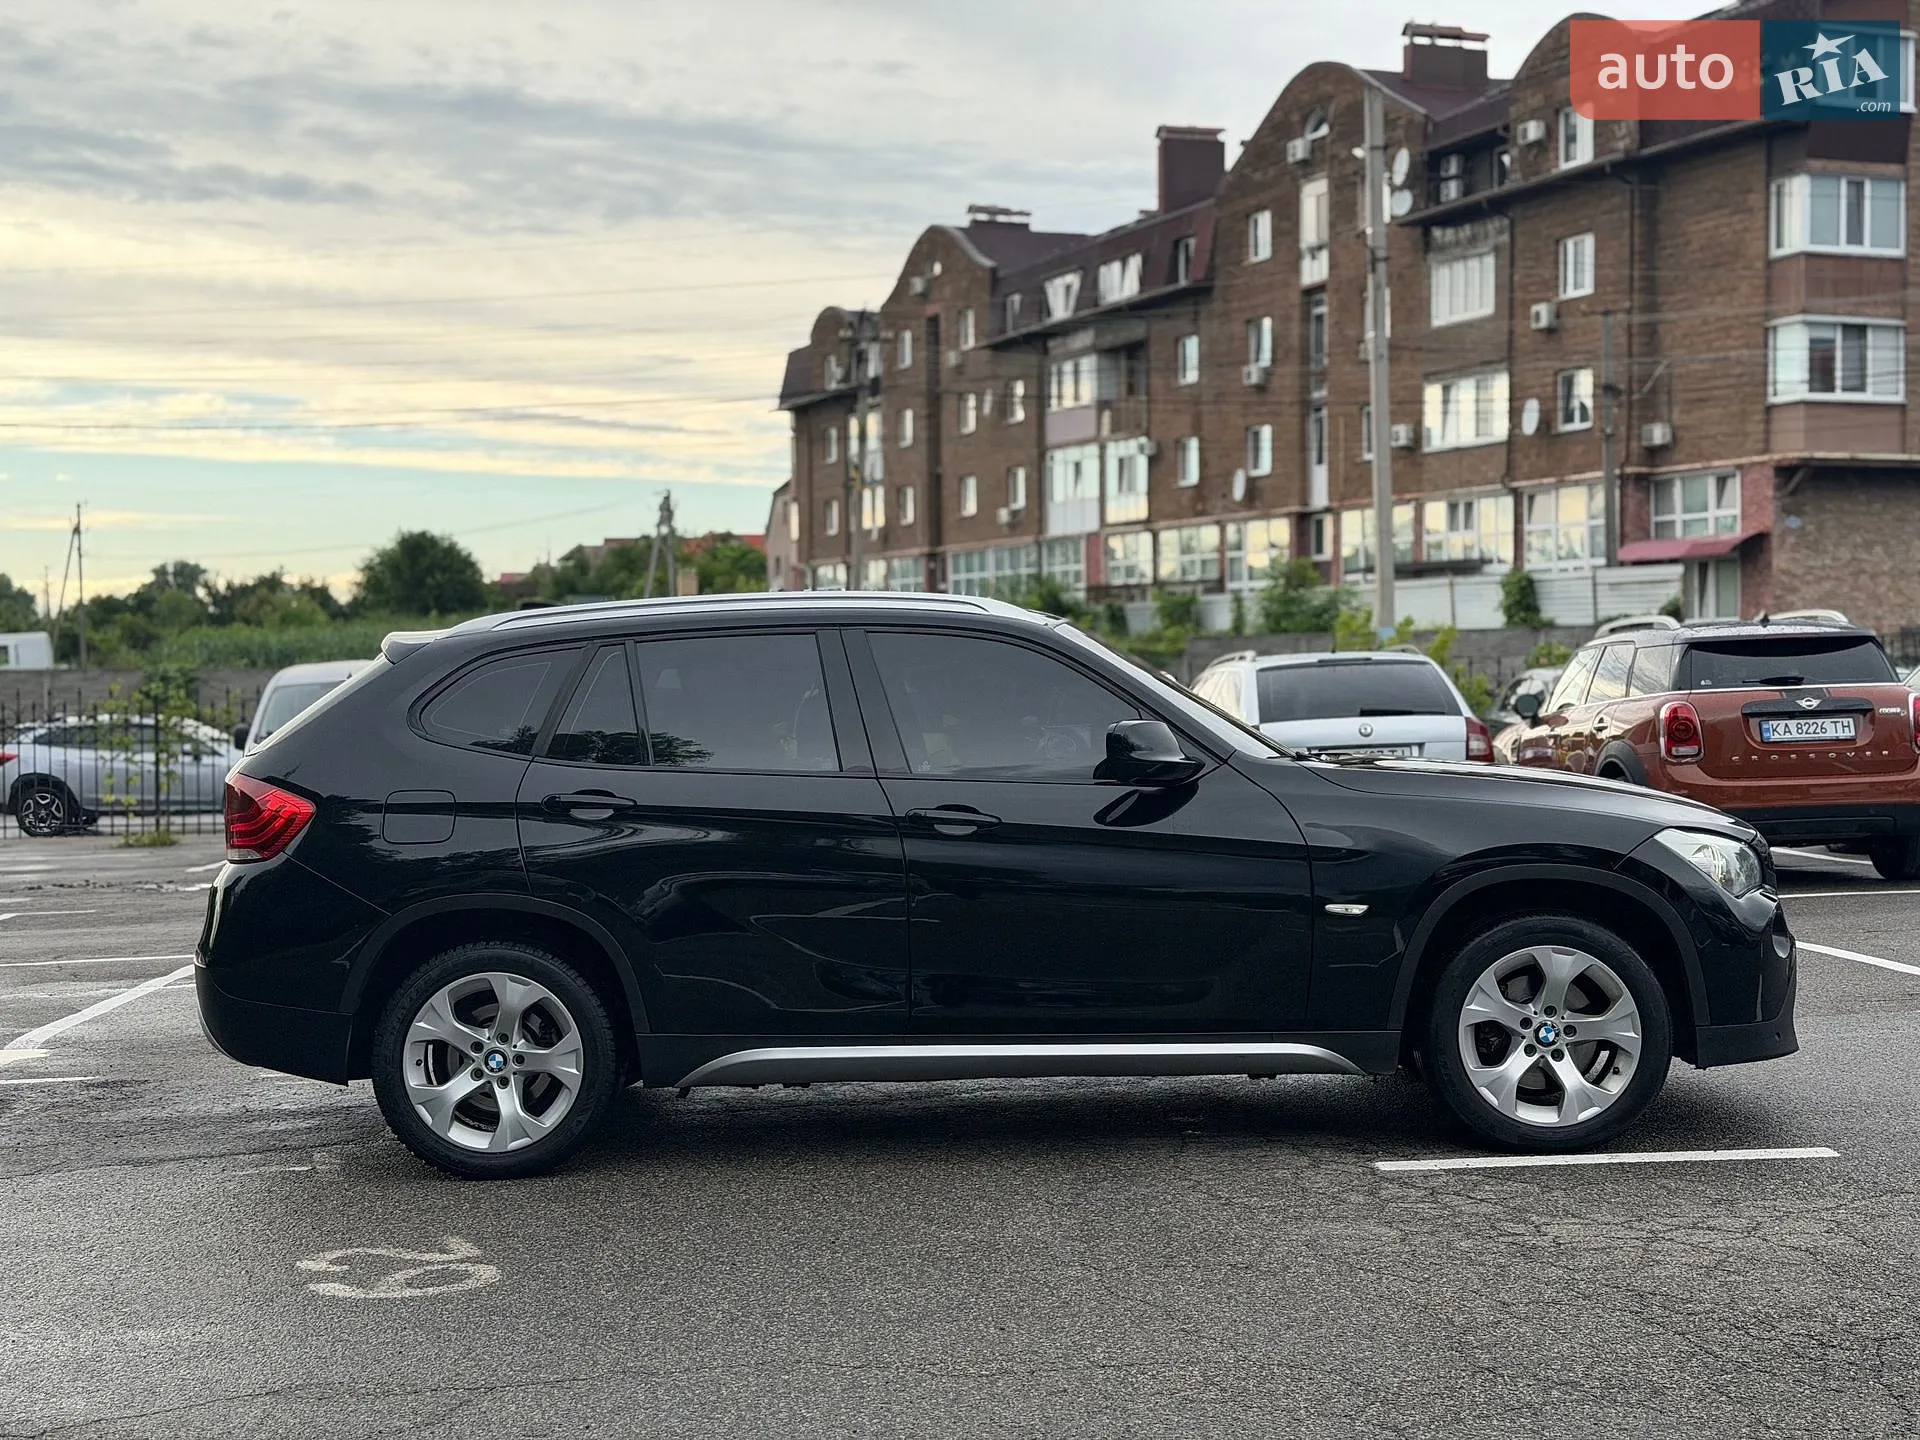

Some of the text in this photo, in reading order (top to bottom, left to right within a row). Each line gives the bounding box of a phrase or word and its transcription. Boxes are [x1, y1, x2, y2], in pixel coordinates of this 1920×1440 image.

[1771, 720, 1852, 737] KA 8226 TH
